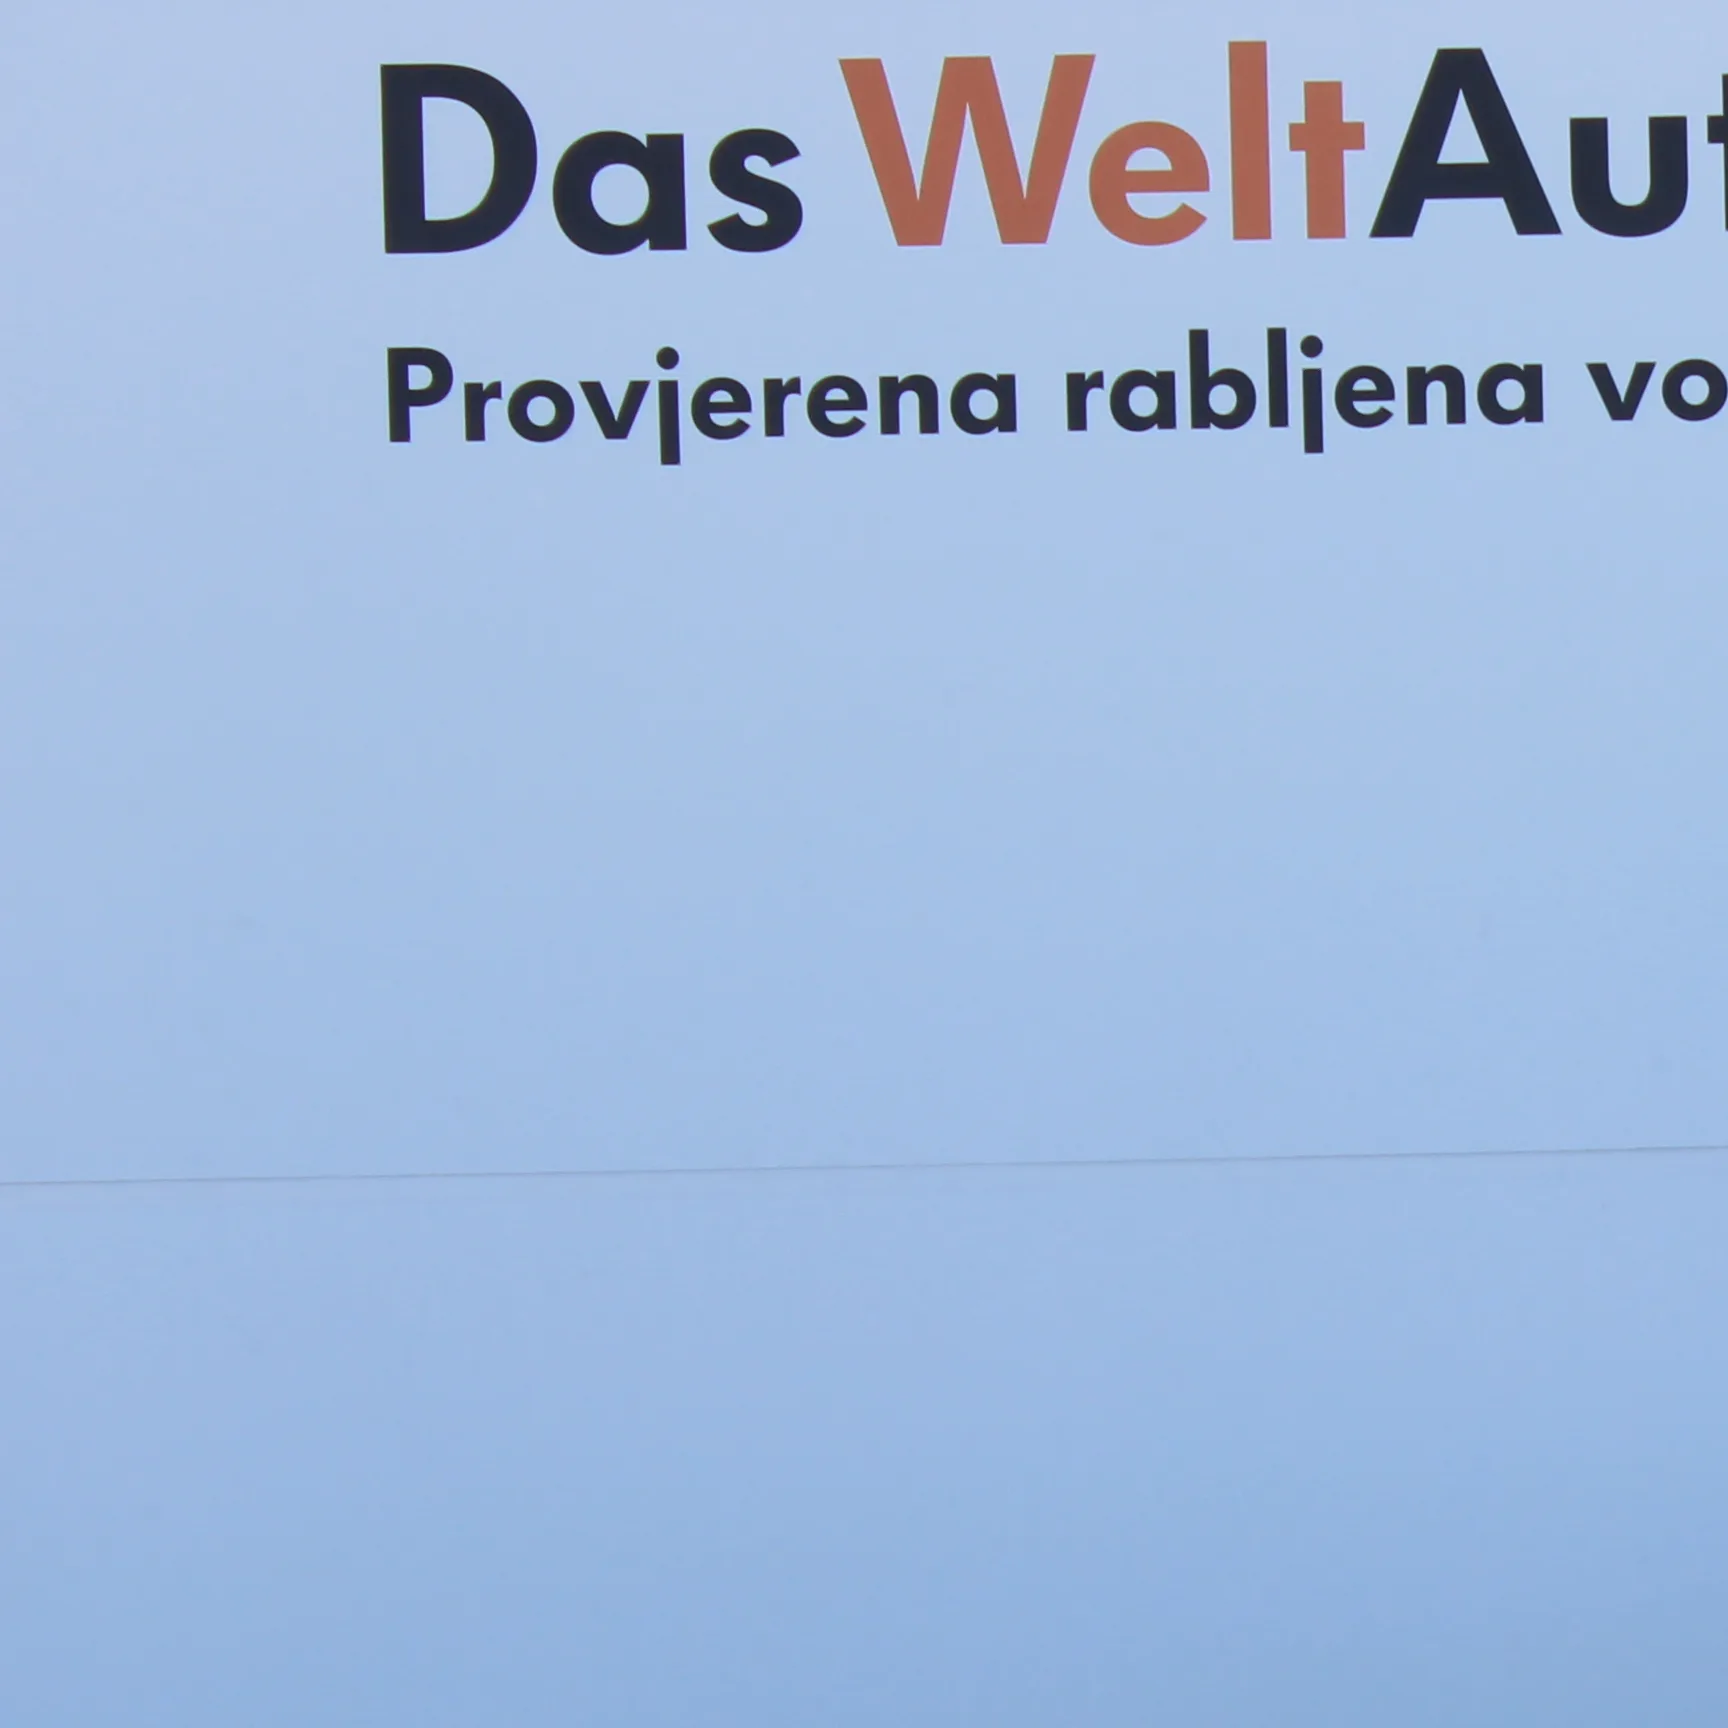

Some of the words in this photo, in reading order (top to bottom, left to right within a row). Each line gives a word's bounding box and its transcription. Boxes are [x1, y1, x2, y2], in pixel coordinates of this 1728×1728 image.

[379, 63, 803, 256] Das
[386, 346, 1017, 466] Provjerena
[1065, 327, 1544, 454] rabljena
